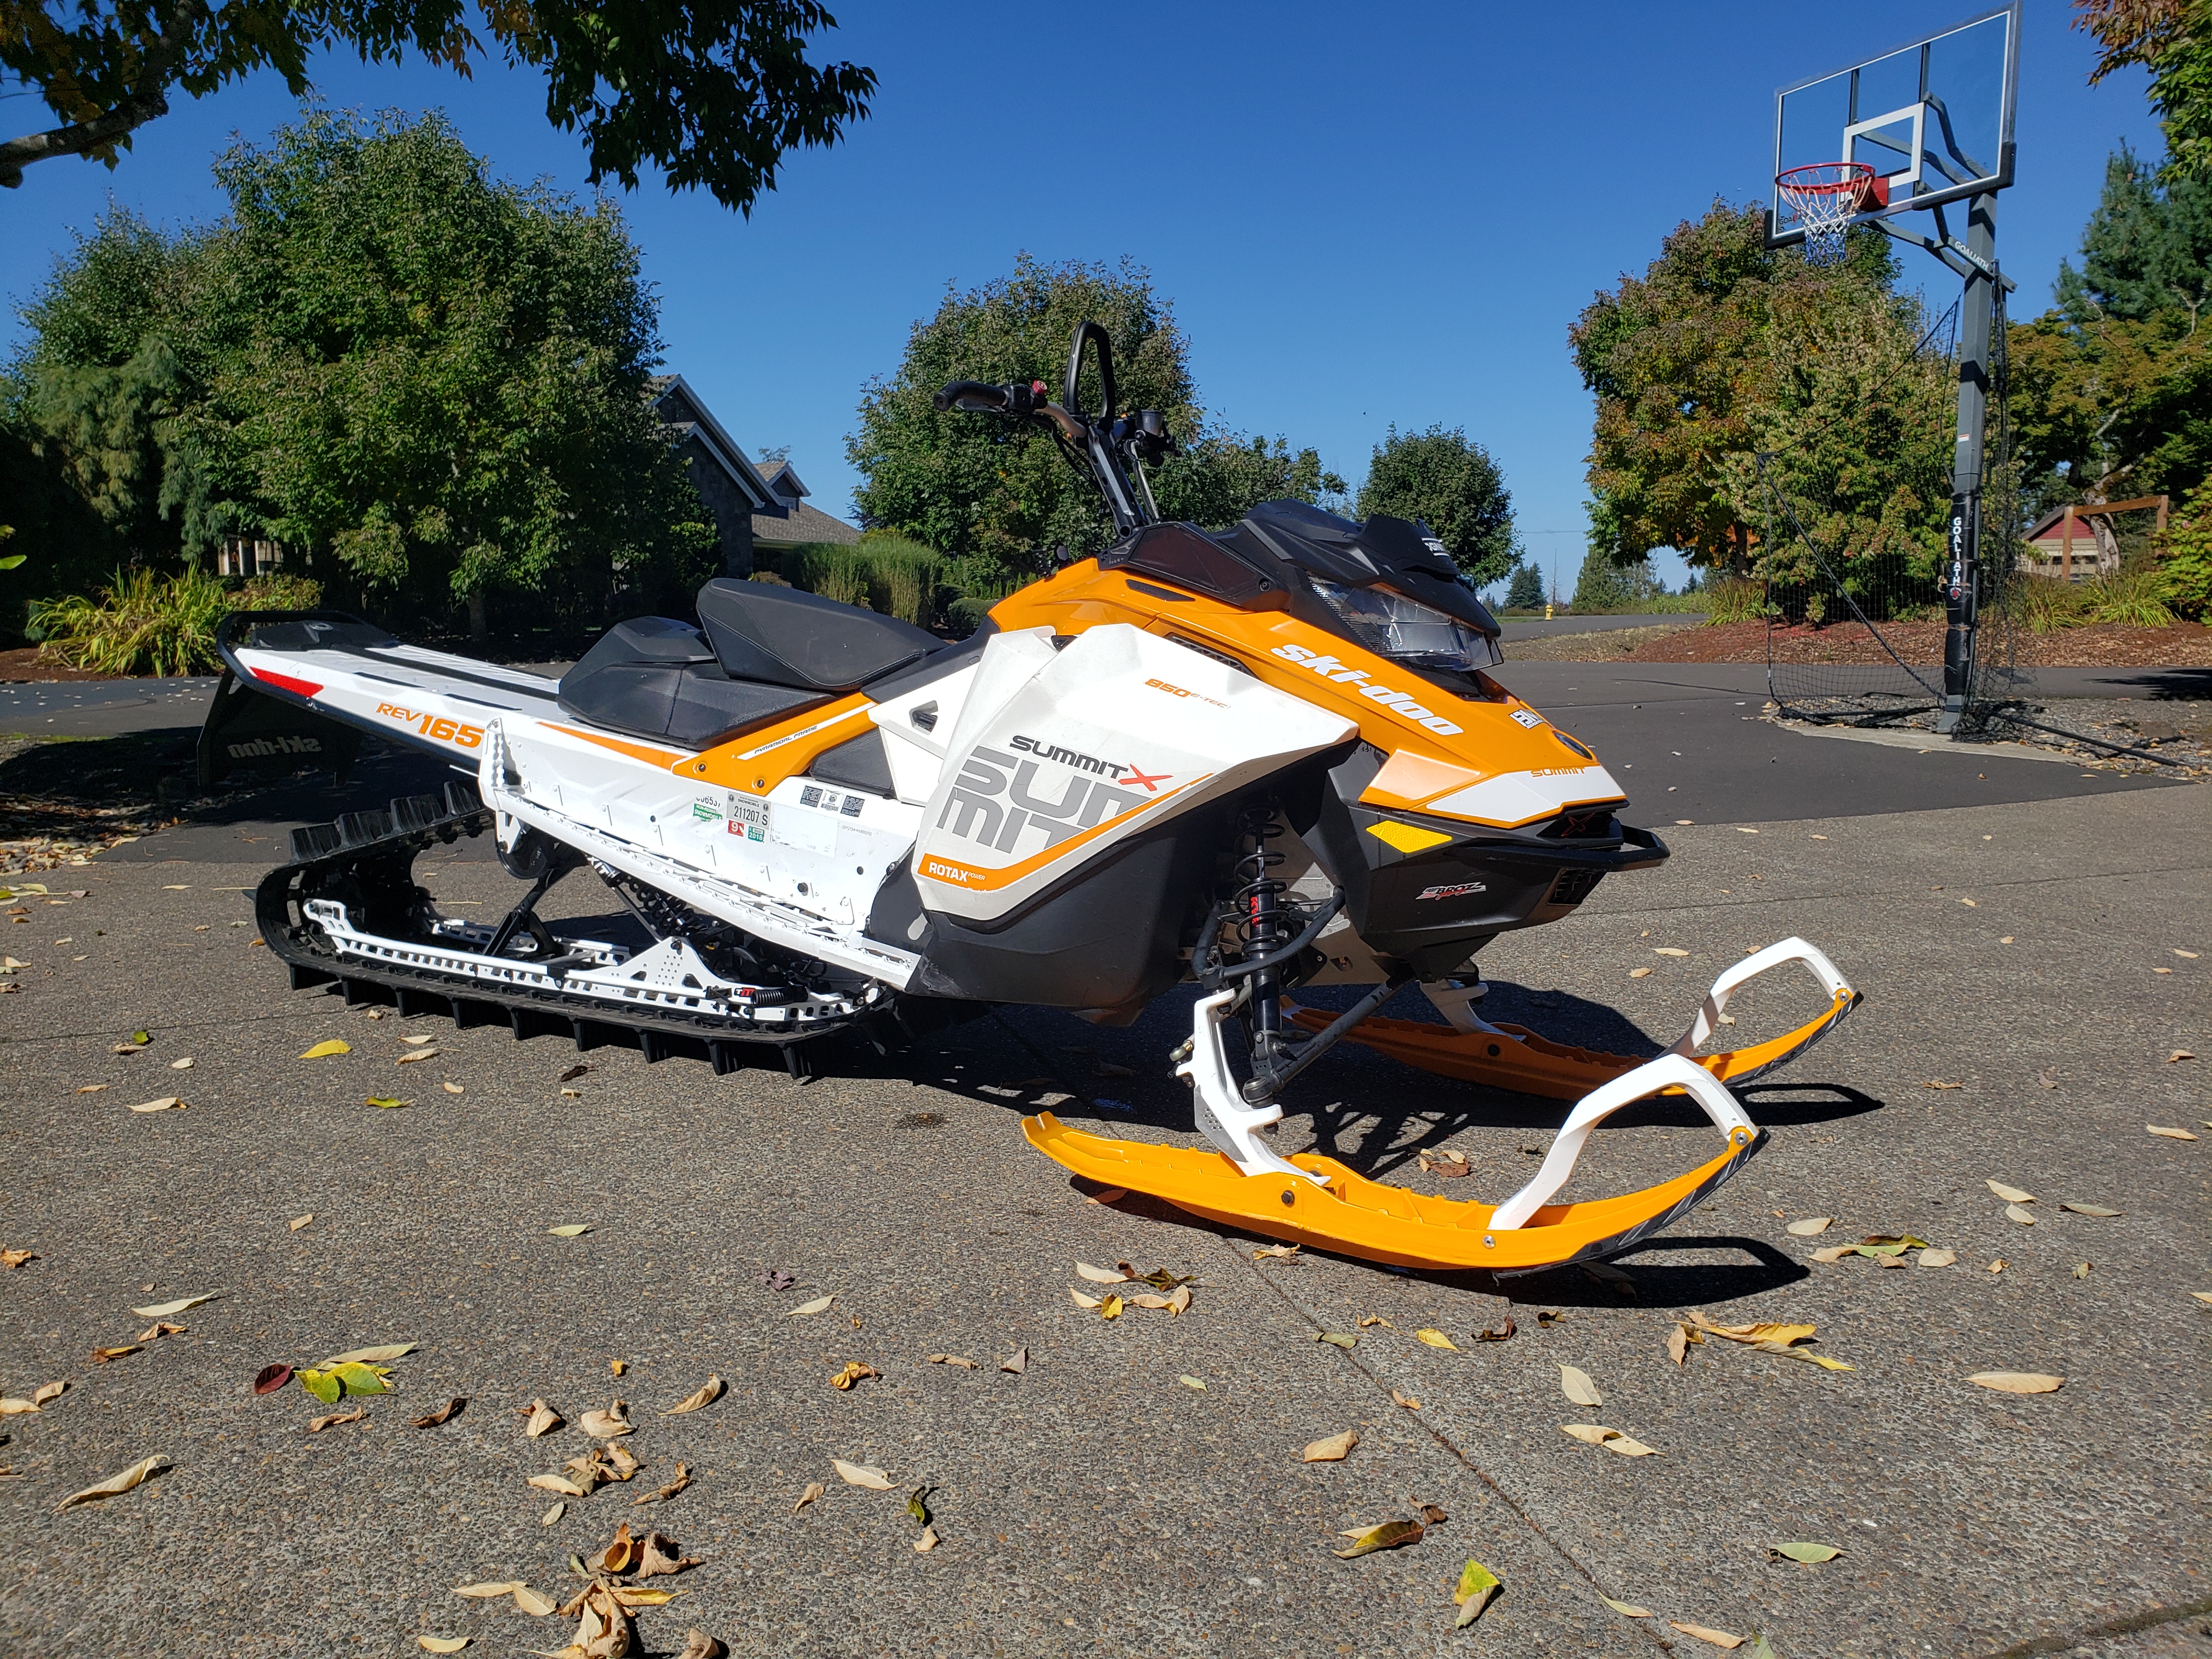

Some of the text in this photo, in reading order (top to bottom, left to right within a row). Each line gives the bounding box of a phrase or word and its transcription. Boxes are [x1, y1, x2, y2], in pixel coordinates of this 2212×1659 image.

[1955, 241, 1989, 270] GOALIATH
[1953, 517, 1962, 586] GOALIATH
[1145, 679, 1192, 698] 850
[1270, 644, 1464, 736] ski-doo
[375, 702, 486, 748] REV 165
[754, 725, 818, 754] PYRAMIDAL FRAME
[1009, 735, 1174, 791] SUMMIT X
[1530, 767, 1586, 778] SUMMIT
[734, 805, 769, 826] 211207 S
[749, 832, 763, 840] 2018
[928, 861, 986, 883] ROTAX POWER
